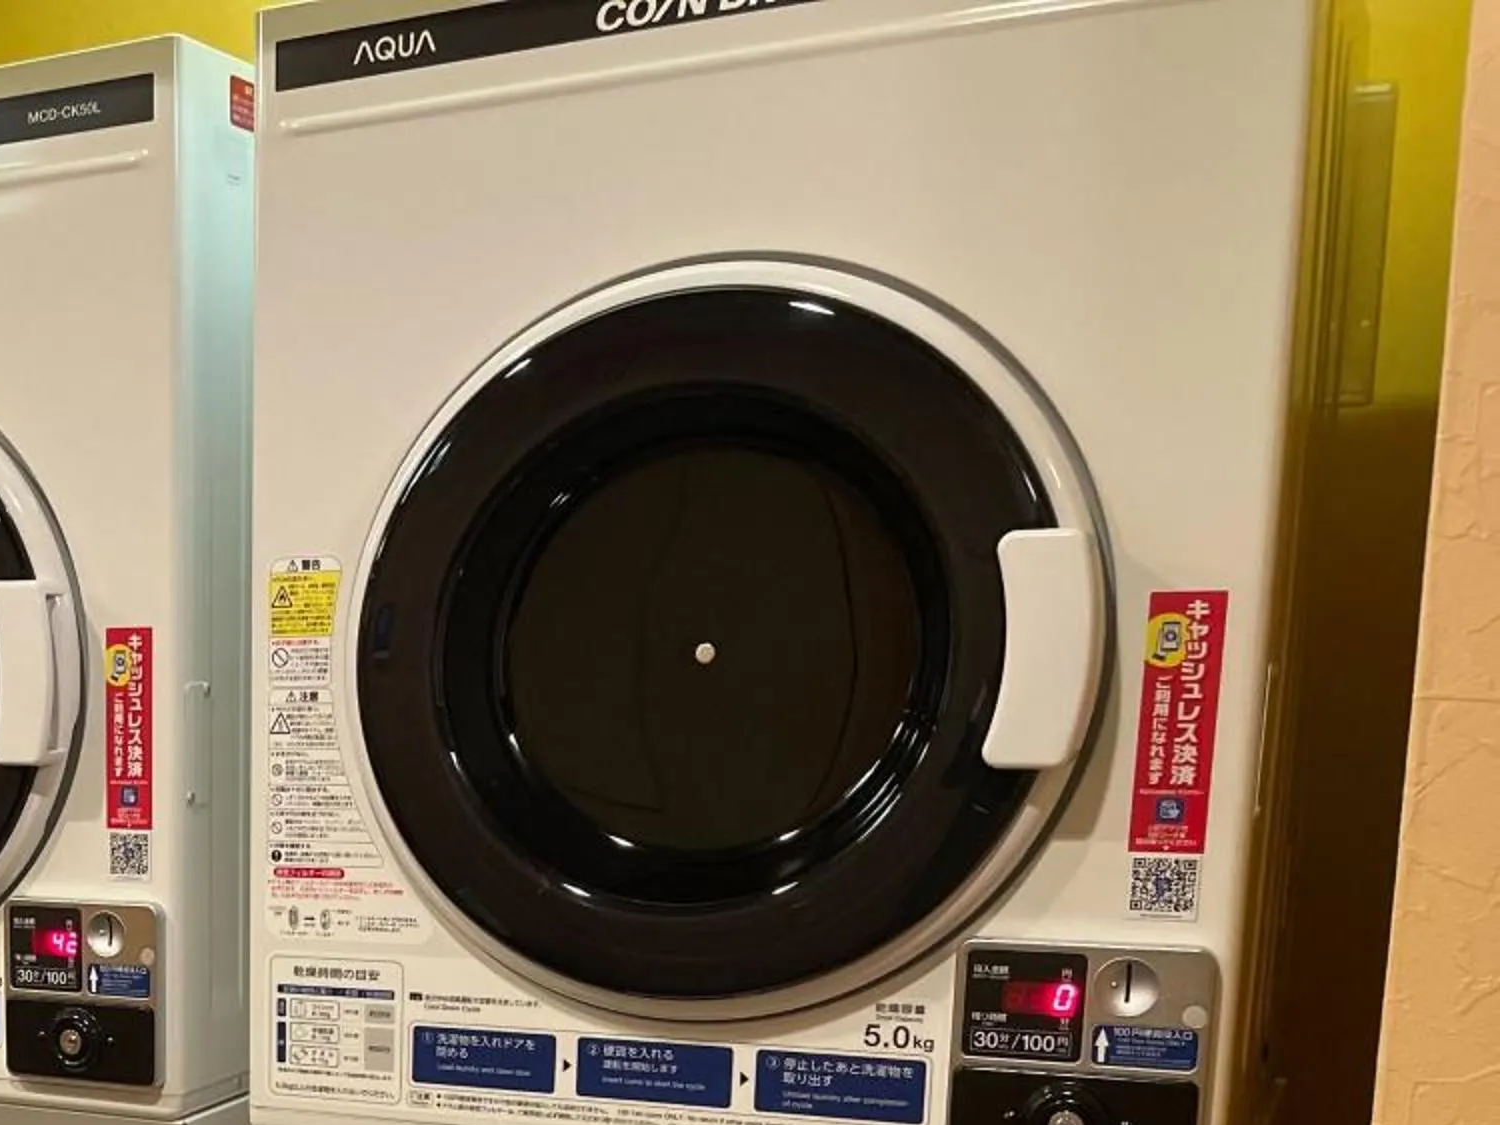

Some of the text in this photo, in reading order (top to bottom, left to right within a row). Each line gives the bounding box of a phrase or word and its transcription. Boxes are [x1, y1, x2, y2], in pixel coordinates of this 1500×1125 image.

[353, 29, 436, 65] AQUA
[1169, 598, 1211, 786] キャッシュレス決済
[1053, 983, 1076, 1012] 0
